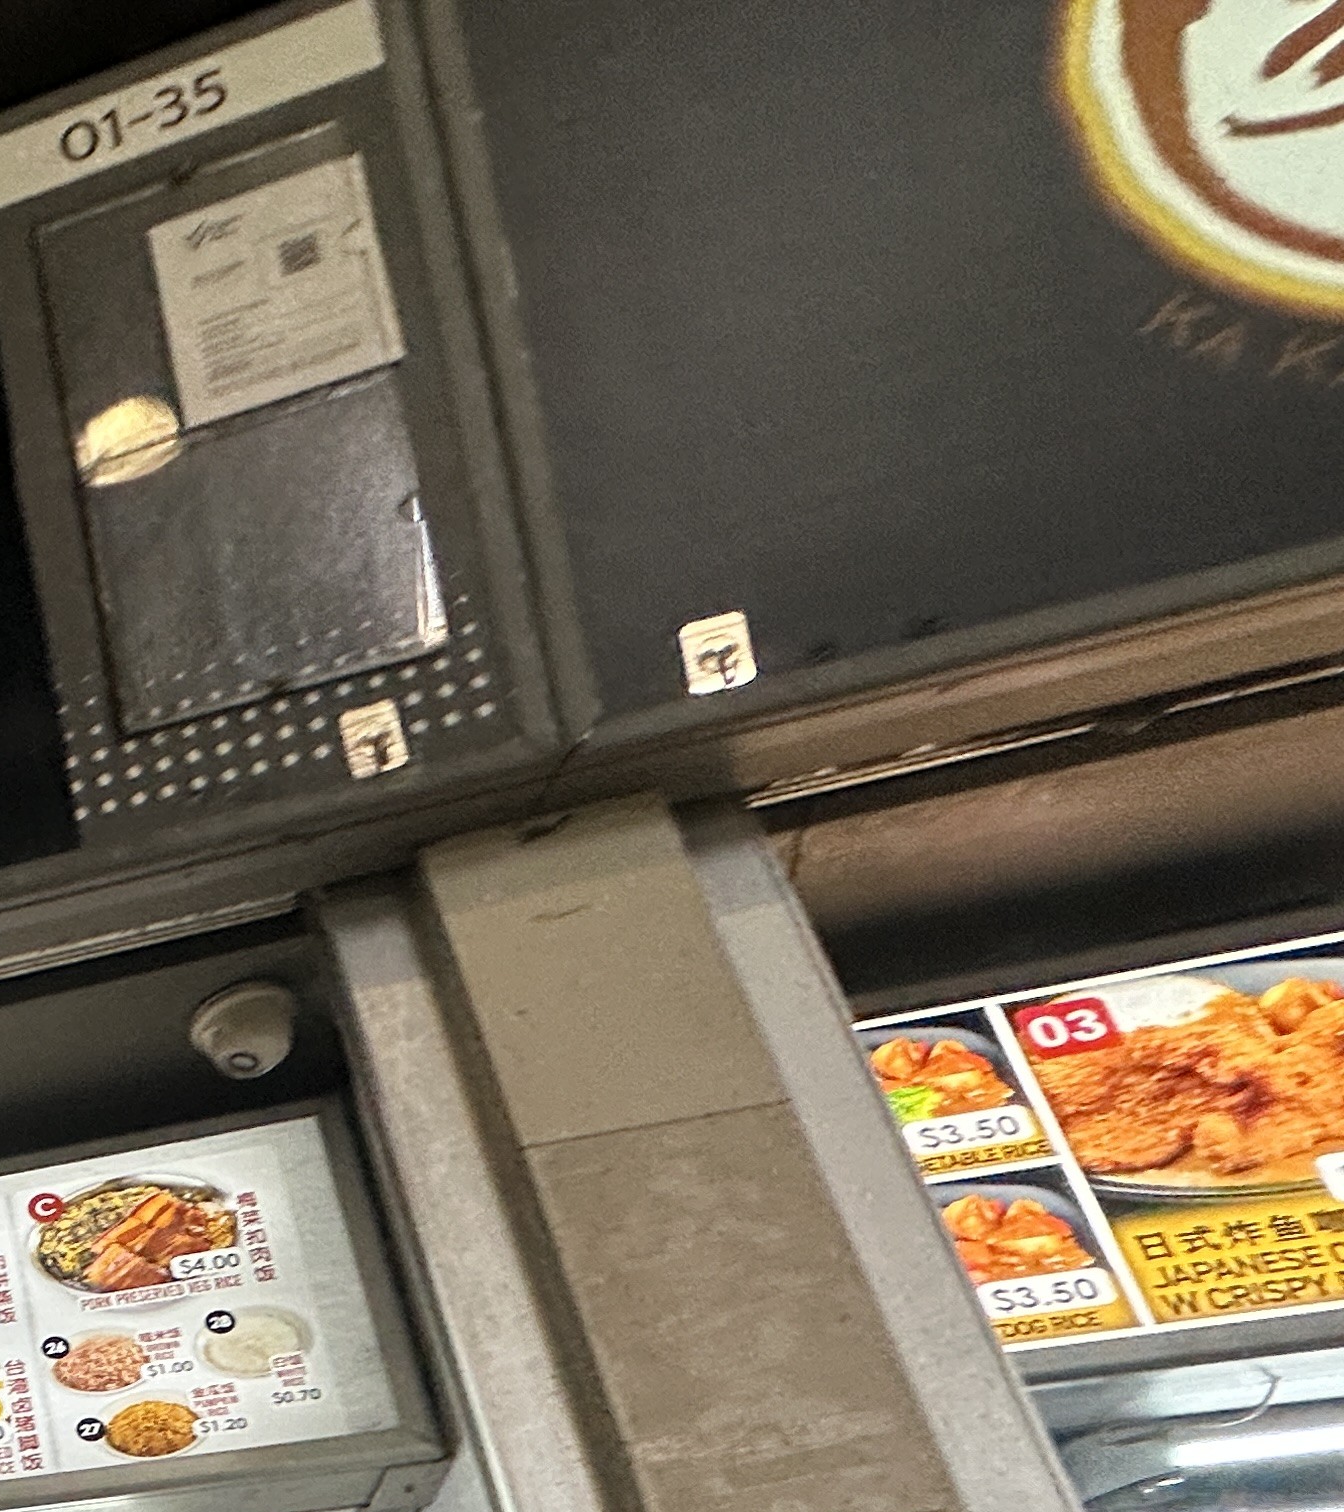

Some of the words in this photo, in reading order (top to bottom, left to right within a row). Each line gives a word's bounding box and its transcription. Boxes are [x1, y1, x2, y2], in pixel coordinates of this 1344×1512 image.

[59, 68, 229, 163] 01-35
[1026, 1009, 1108, 1049] 03
[919, 1116, 1021, 1148] $3.50
[35, 1198, 57, 1217] C
[179, 1253, 241, 1274] $4.00
[1153, 1245, 1328, 1288] JAPANESE
[990, 1277, 1100, 1313] $3.50
[1206, 1274, 1330, 1309] CRISPY
[1050, 1311, 1102, 1332] RICE
[147, 1361, 194, 1377] $1.00
[199, 1418, 248, 1433] $1.20
